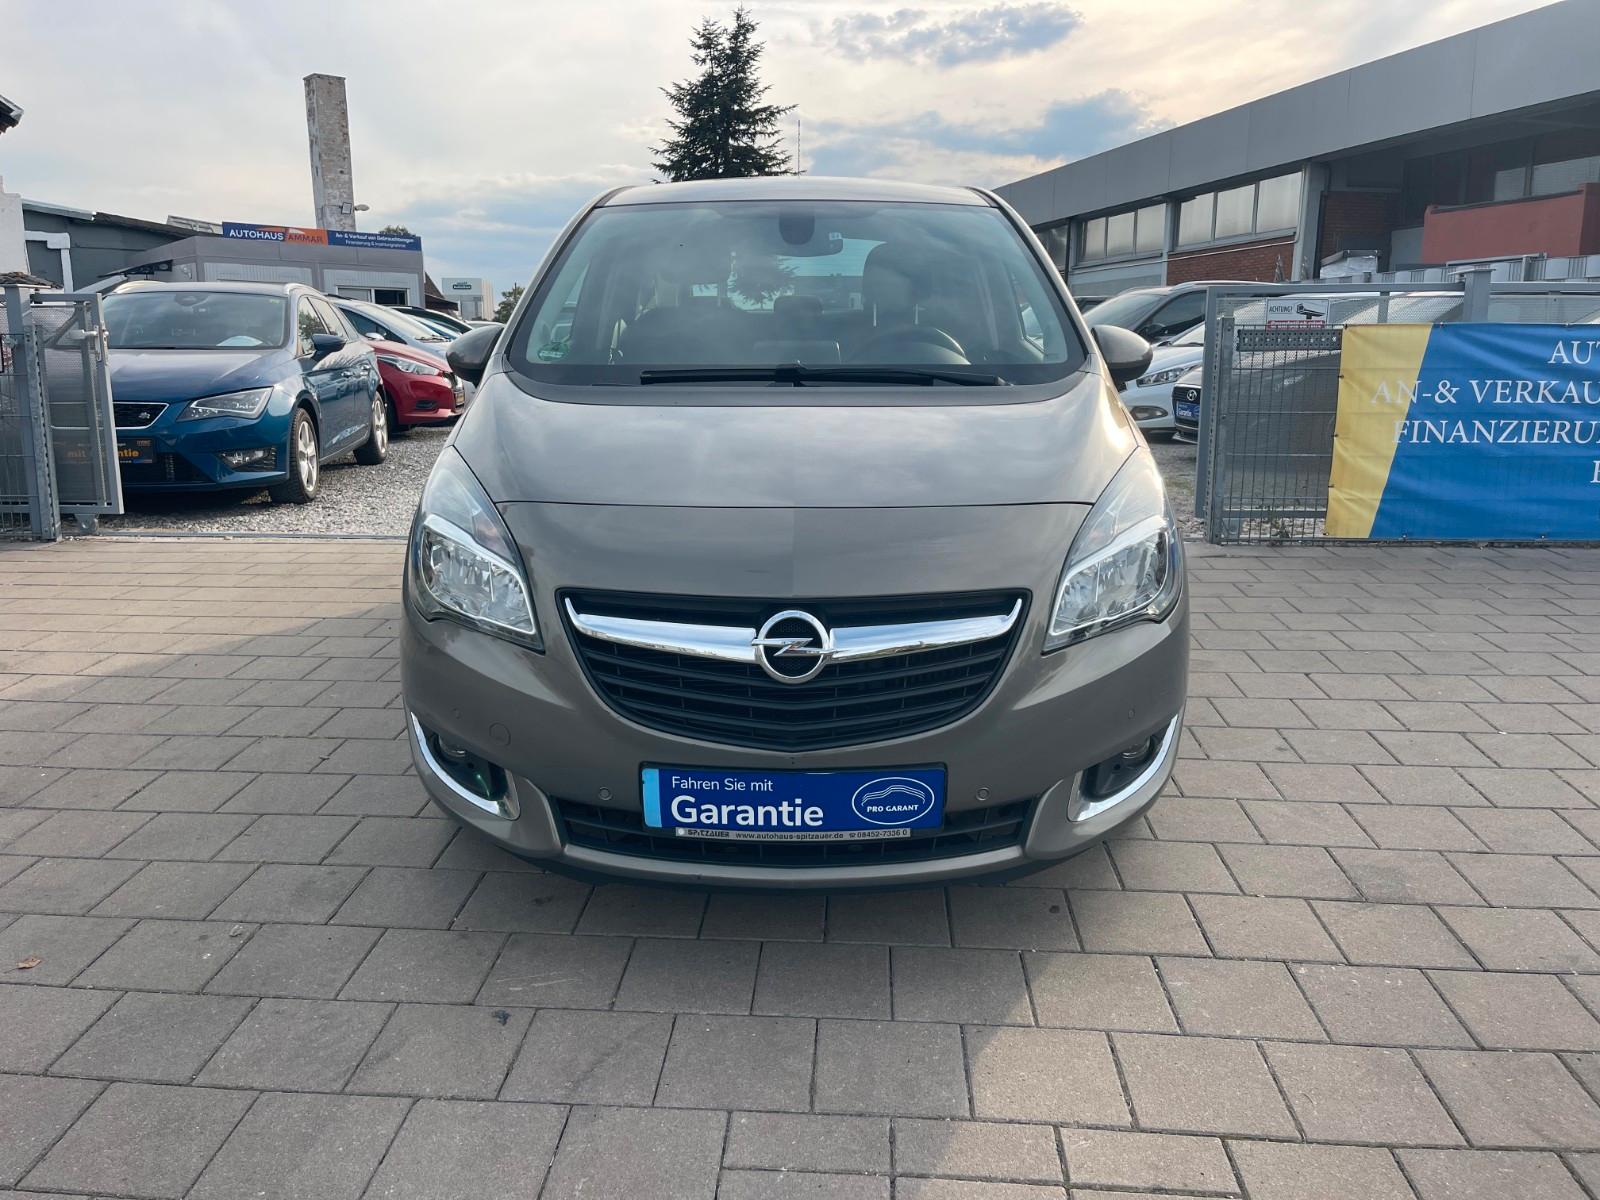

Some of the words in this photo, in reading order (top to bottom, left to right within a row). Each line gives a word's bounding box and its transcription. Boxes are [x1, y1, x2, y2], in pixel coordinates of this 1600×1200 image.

[229, 229, 284, 241] AUTOHAUS
[1548, 340, 1600, 365] AU
[1392, 420, 1600, 445] FINANZIERU
[671, 776, 720, 791] Fahren
[723, 778, 747, 791] Sie
[750, 779, 774, 792] mit
[670, 794, 825, 827] Garantie
[867, 805, 884, 813] PRO
[885, 804, 919, 812] GARANT
[735, 832, 844, 841] www.autohaus-spitzauer.de
